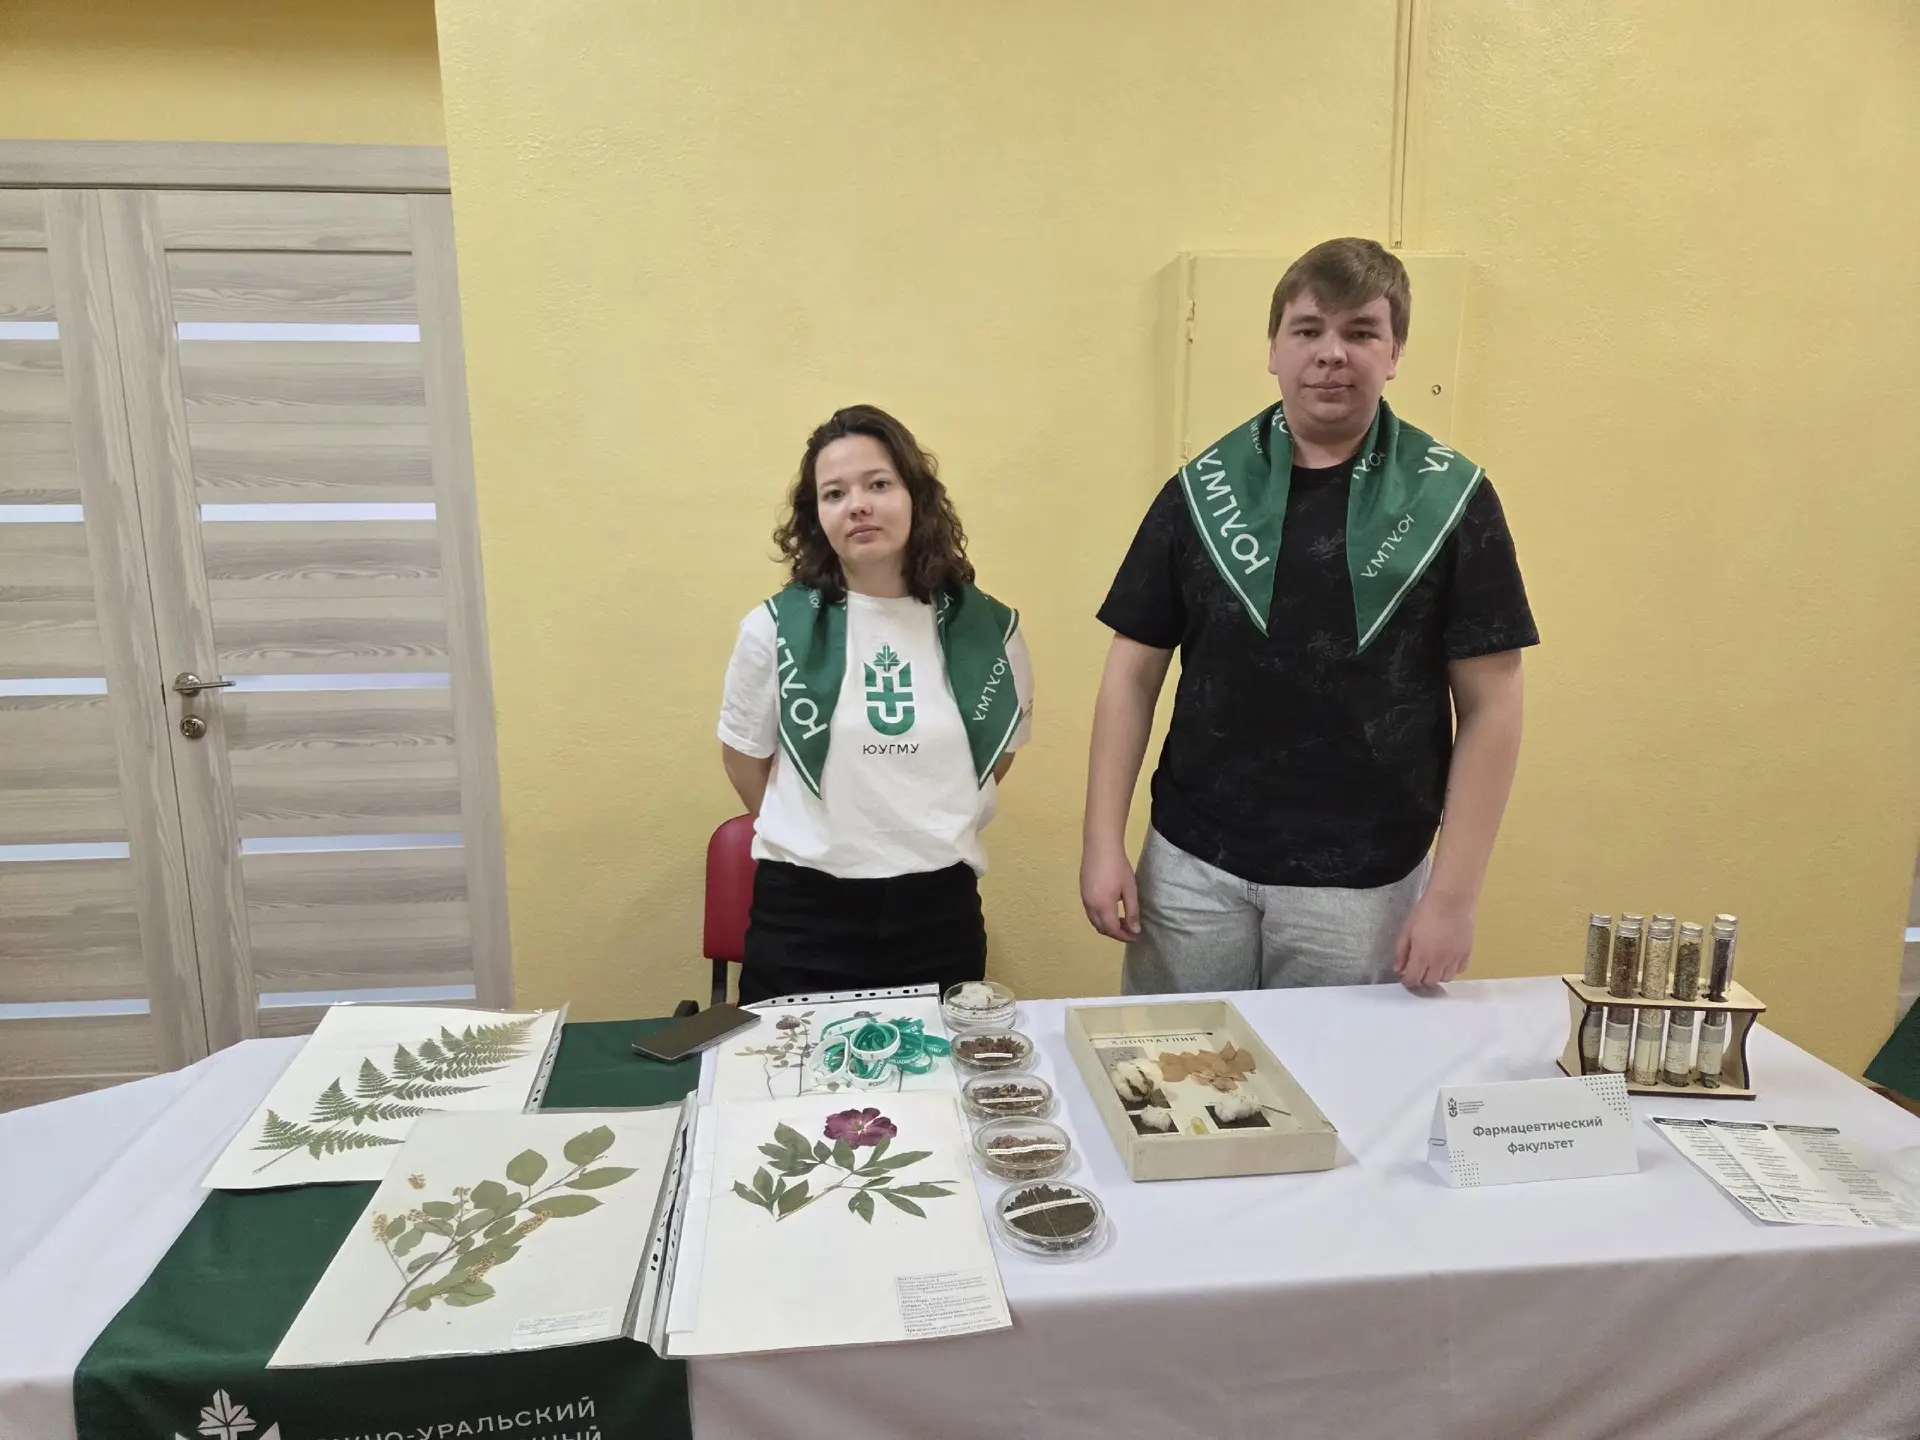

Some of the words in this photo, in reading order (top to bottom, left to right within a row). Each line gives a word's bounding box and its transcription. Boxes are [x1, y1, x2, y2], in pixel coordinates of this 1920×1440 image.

[863, 744, 919, 755] ЮУГМУ
[1473, 1116, 1603, 1138] Фармацевтический
[1507, 1138, 1575, 1155] факультет
